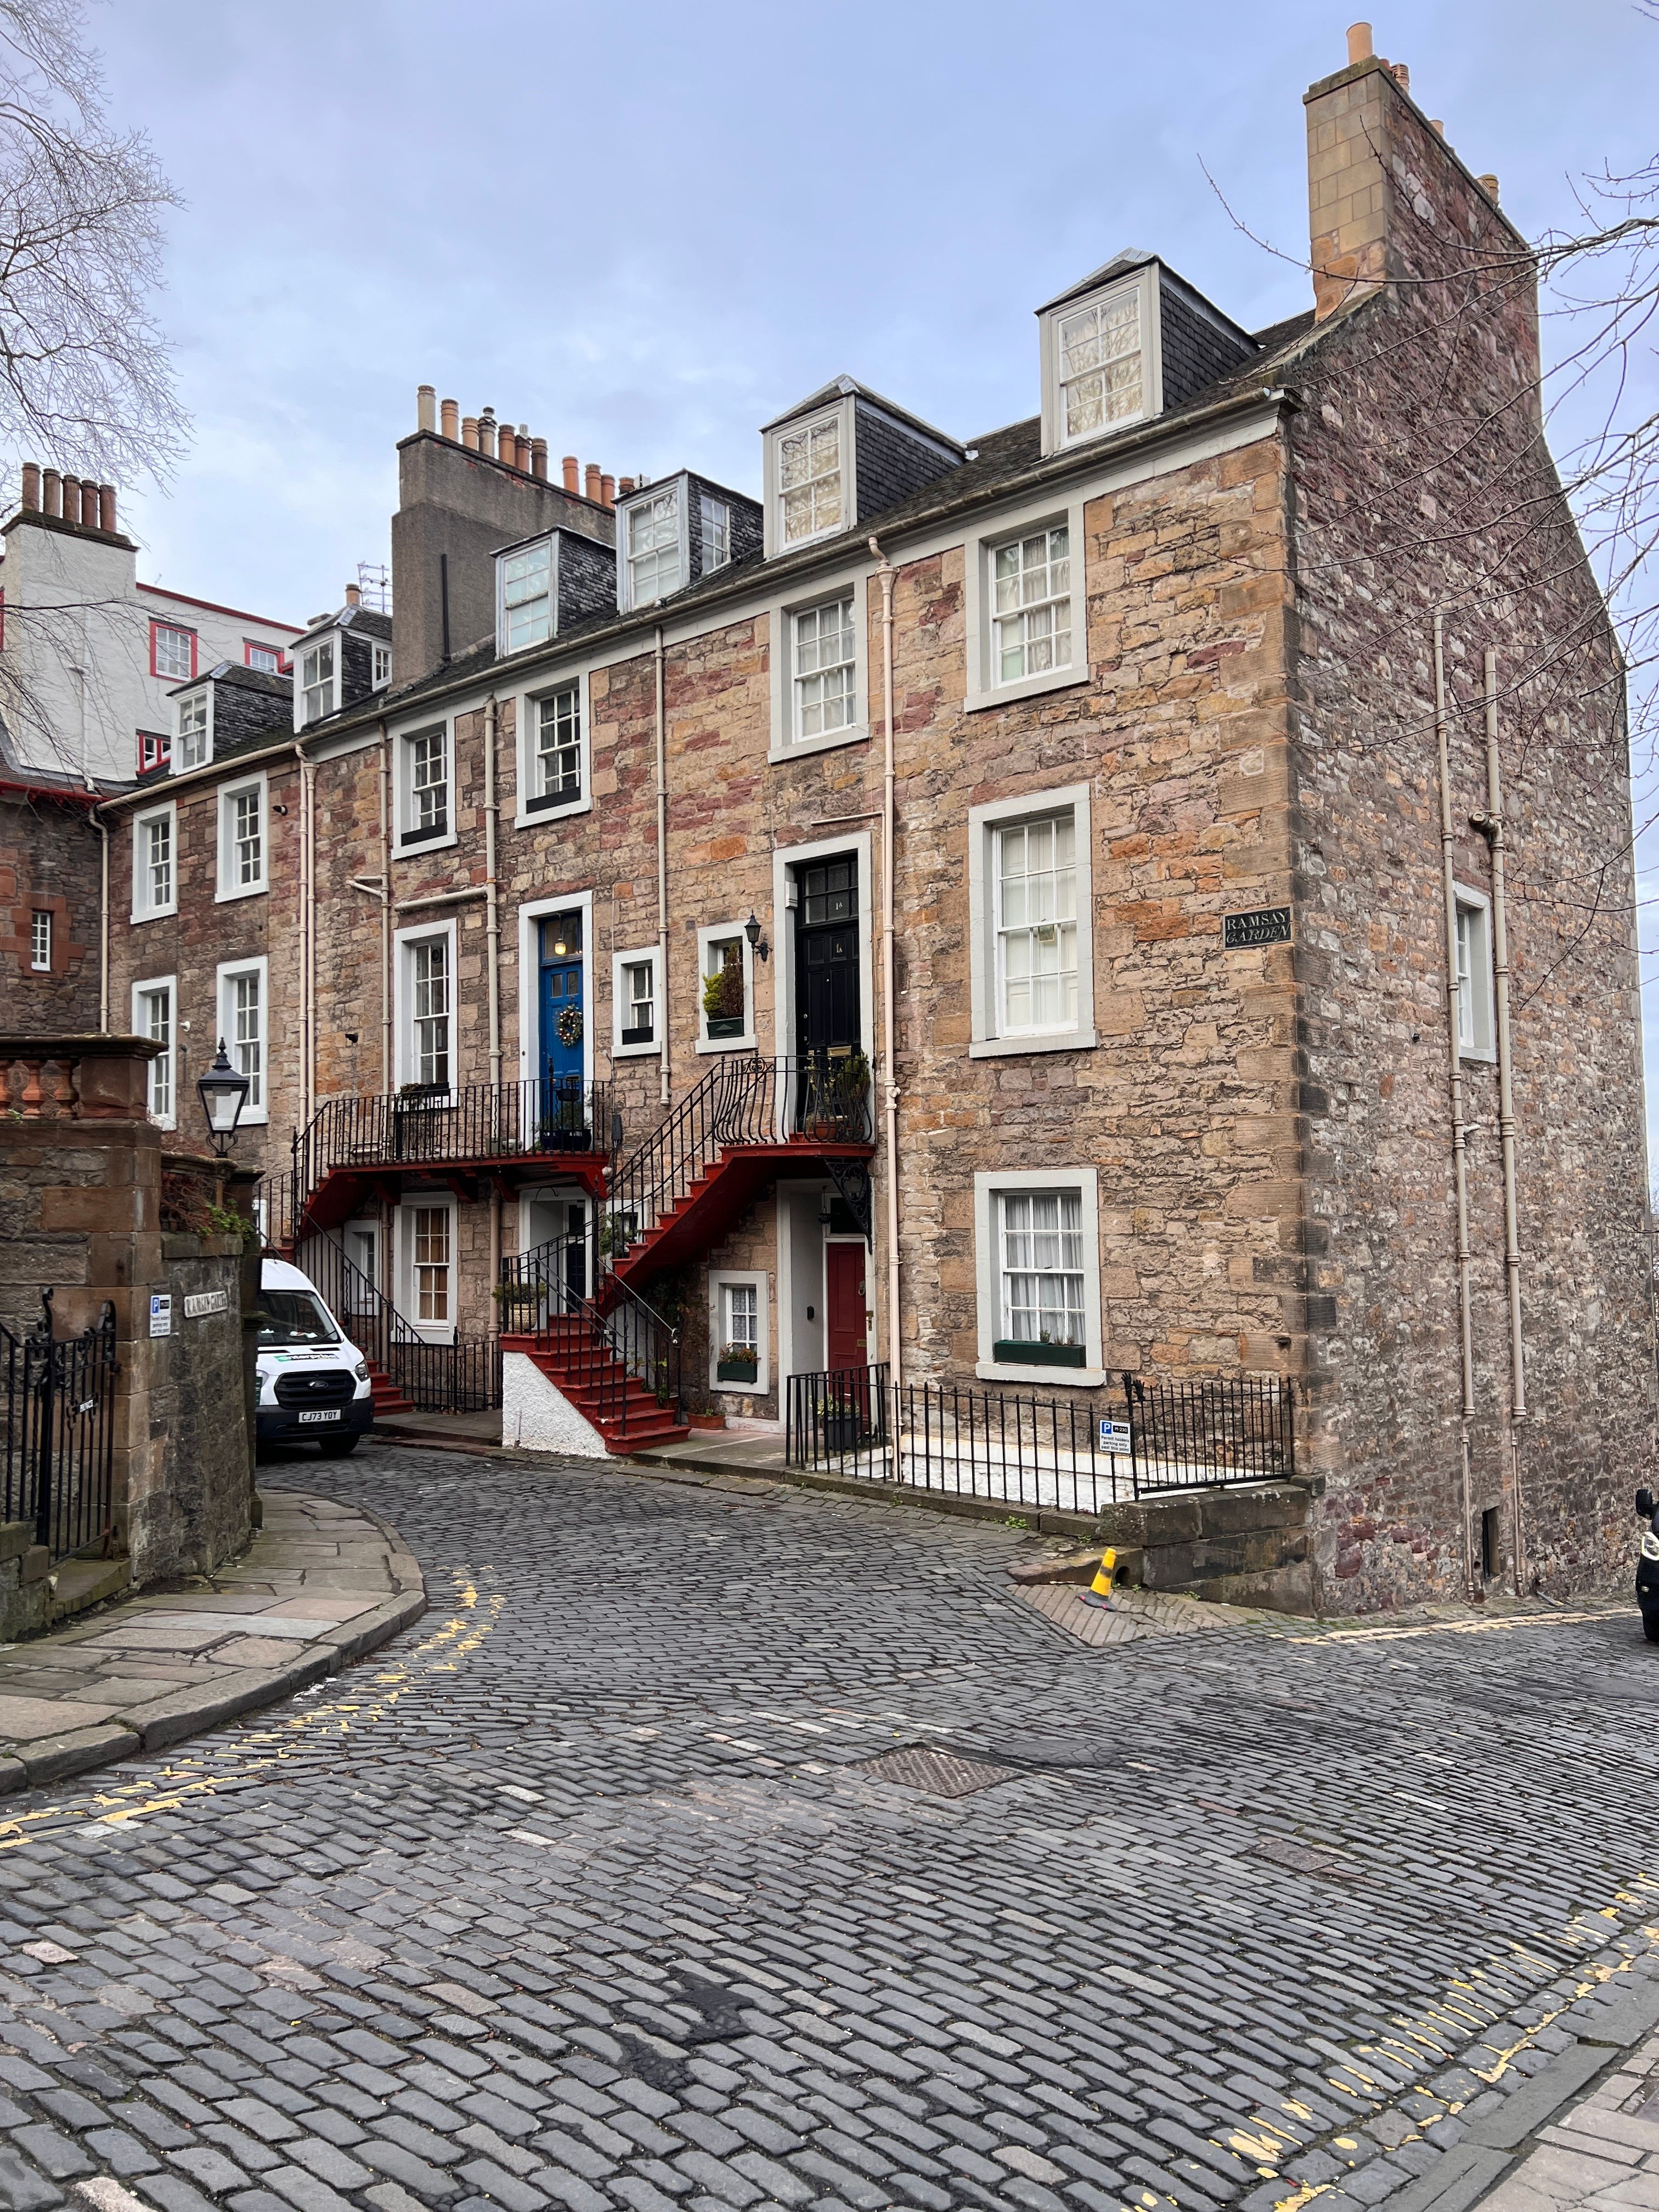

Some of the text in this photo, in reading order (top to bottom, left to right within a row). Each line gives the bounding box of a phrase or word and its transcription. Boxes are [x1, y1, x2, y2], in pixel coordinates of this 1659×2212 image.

[1226, 911, 1288, 930] RAMSAY
[1227, 921, 1293, 943] GARDEN
[278, 1353, 337, 1362] enterprise
[302, 1412, 321, 1421] CJ73
[1104, 1423, 1111, 1432] P
